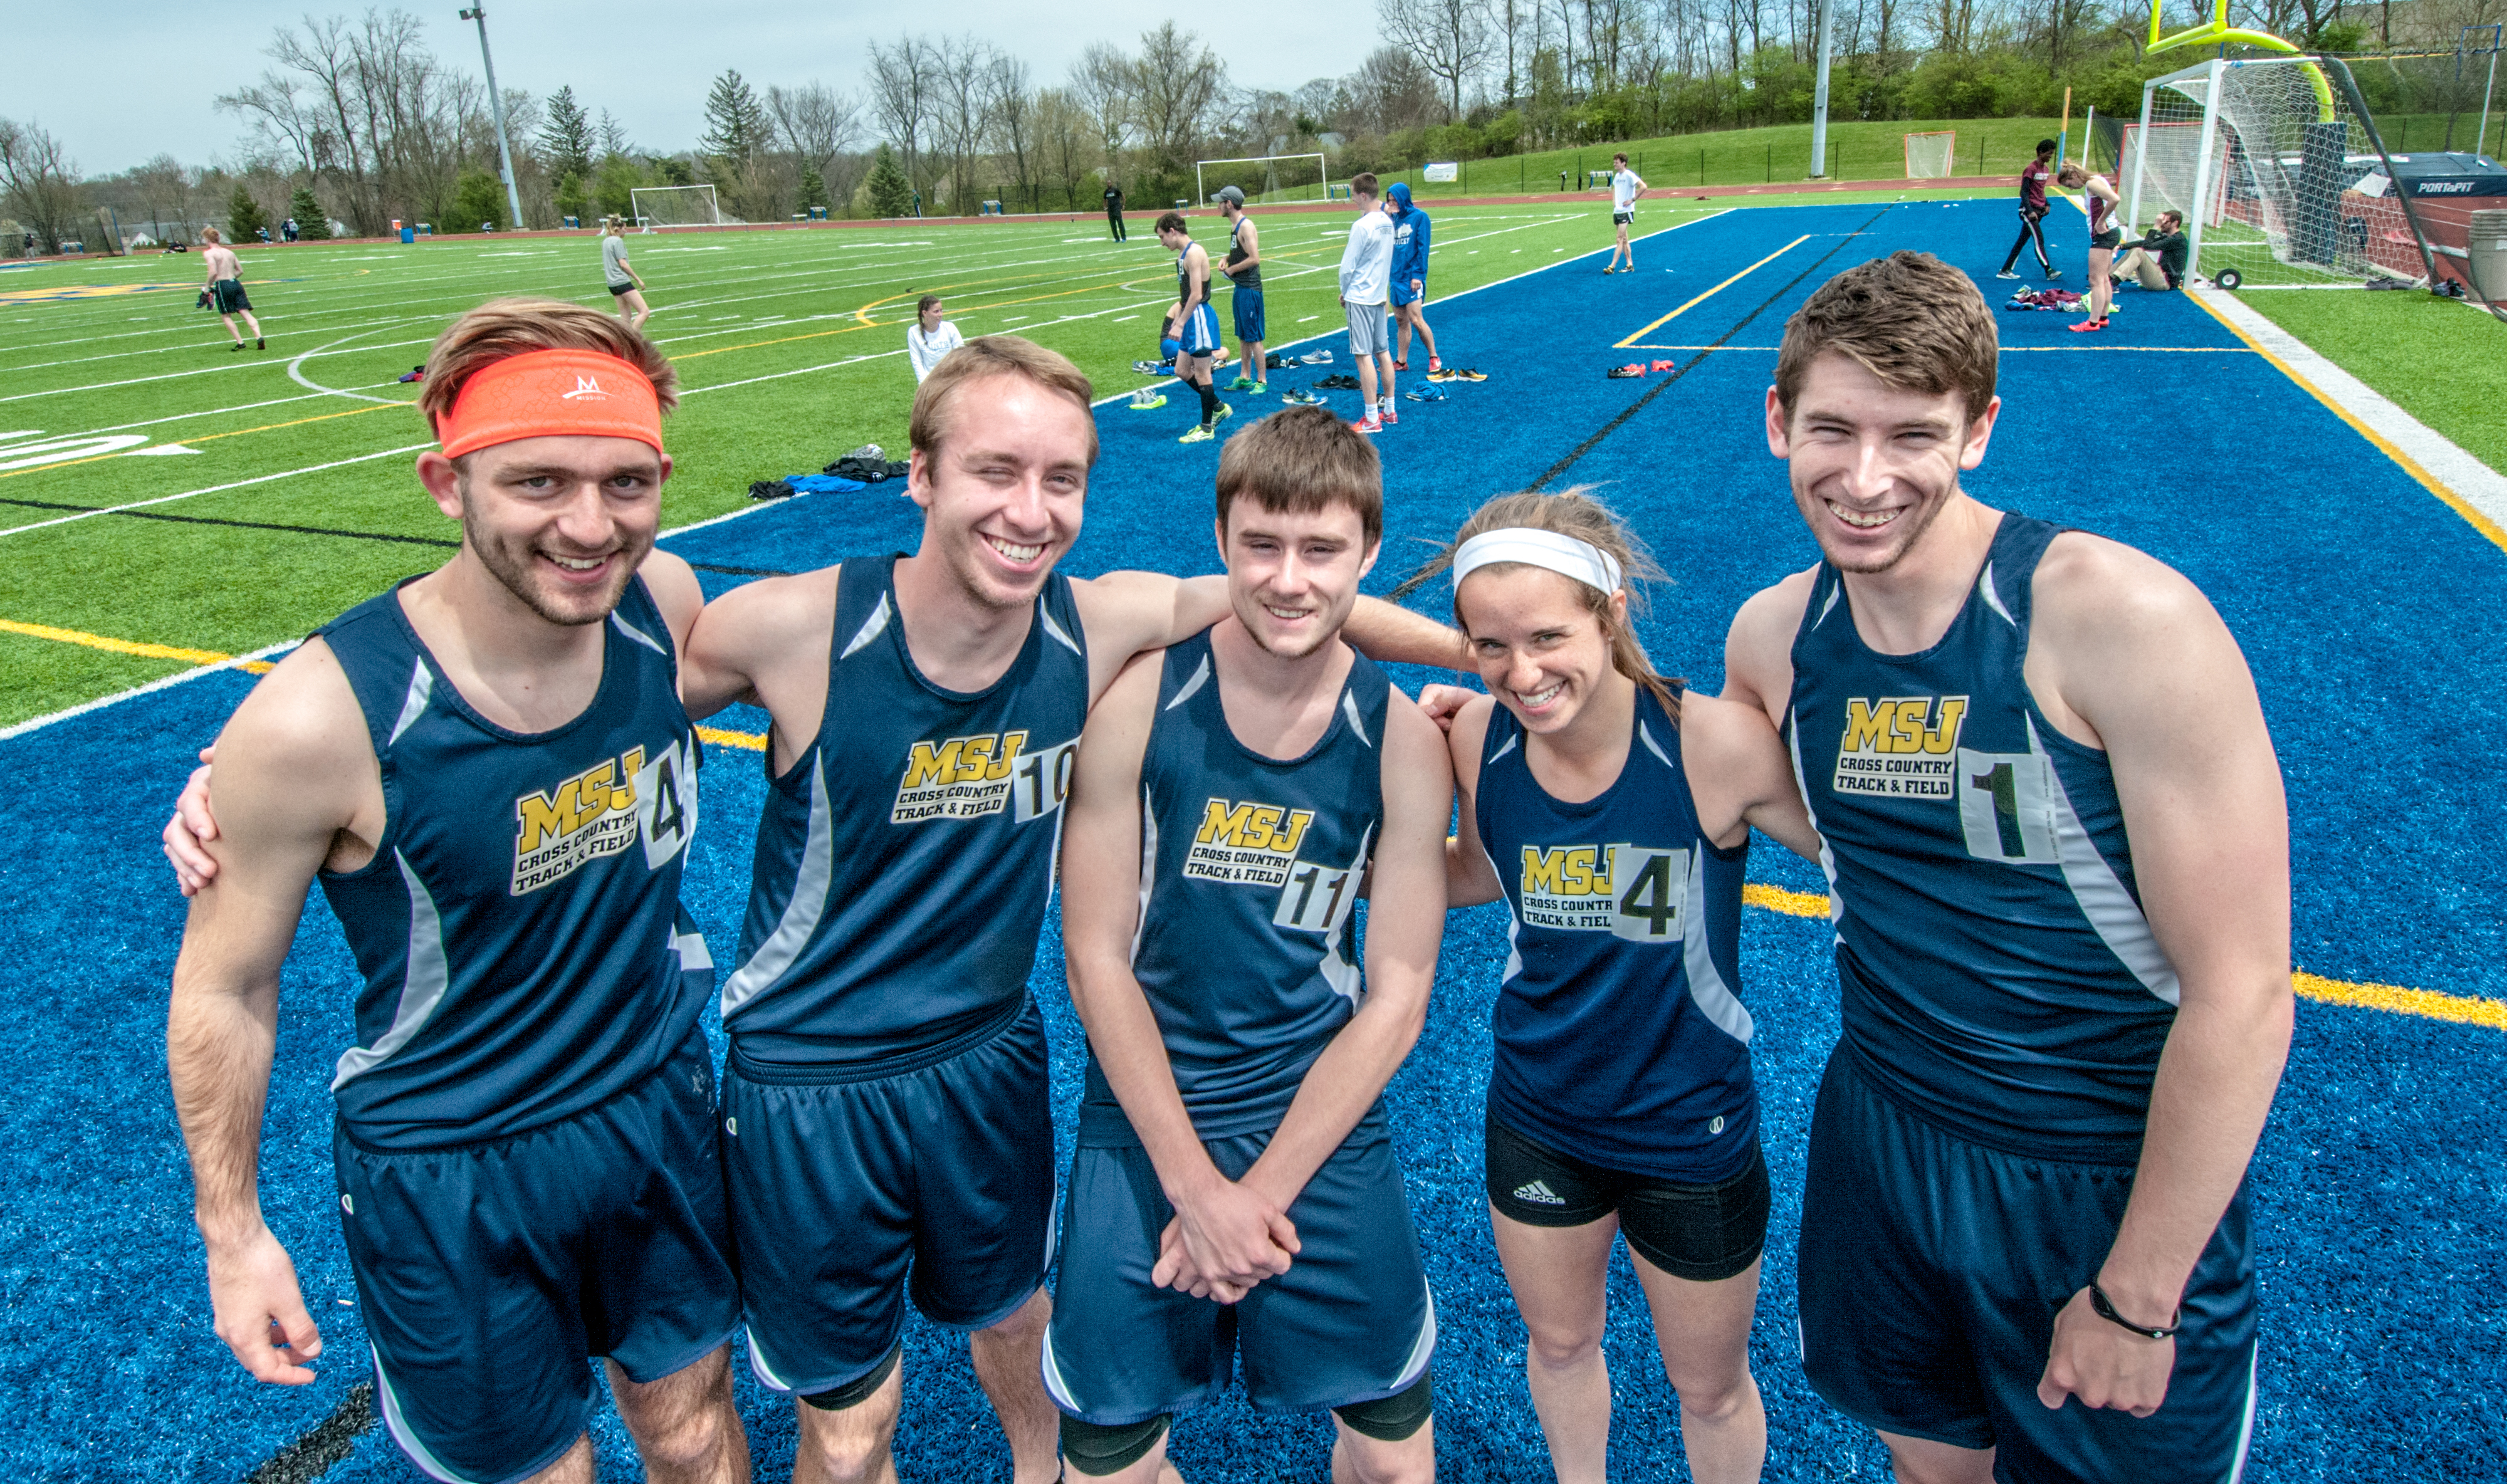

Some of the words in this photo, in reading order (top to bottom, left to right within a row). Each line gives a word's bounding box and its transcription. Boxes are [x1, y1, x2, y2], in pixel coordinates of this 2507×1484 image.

[1845, 699, 1965, 755] MSJ
[903, 733, 1024, 790] MSJ
[1020, 744, 1077, 817] 10
[1838, 775, 1886, 792] TRACK
[1891, 780, 1900, 793] &
[1905, 780, 1949, 795] FIELD
[1841, 757, 1882, 772] CROSS
[1887, 760, 1952, 775] COUNTRY
[520, 749, 643, 855] MSJ
[650, 755, 684, 842] 4
[896, 805, 943, 820] TRACK
[948, 803, 956, 815] &
[960, 799, 1002, 816] FIELD
[899, 790, 943, 804] CROSS
[947, 783, 1008, 798] COUNTRY
[1972, 763, 2026, 857] 1
[519, 840, 570, 873] CROSS
[574, 808, 637, 848] COUNTRY
[1196, 801, 1311, 852] MSJ
[516, 855, 573, 892] TRACK
[577, 850, 586, 862] &
[590, 827, 634, 855] FIELD
[1188, 862, 1232, 879] TRACK
[1233, 869, 1242, 880] &
[1246, 870, 1284, 884] FIELD
[1192, 847, 1232, 863] CROSS
[1233, 852, 1291, 868] COUNTRY
[1523, 847, 1615, 896] MSJ
[1290, 867, 1349, 928] 11
[1524, 897, 1557, 909] CROSS
[1561, 901, 1613, 911] COUNTR
[1525, 911, 1563, 926] TRACK
[1568, 916, 1576, 926] &
[1580, 916, 1612, 927] FIEL
[1620, 854, 1676, 935] 4
[1514, 1190, 1566, 1205] adidas
